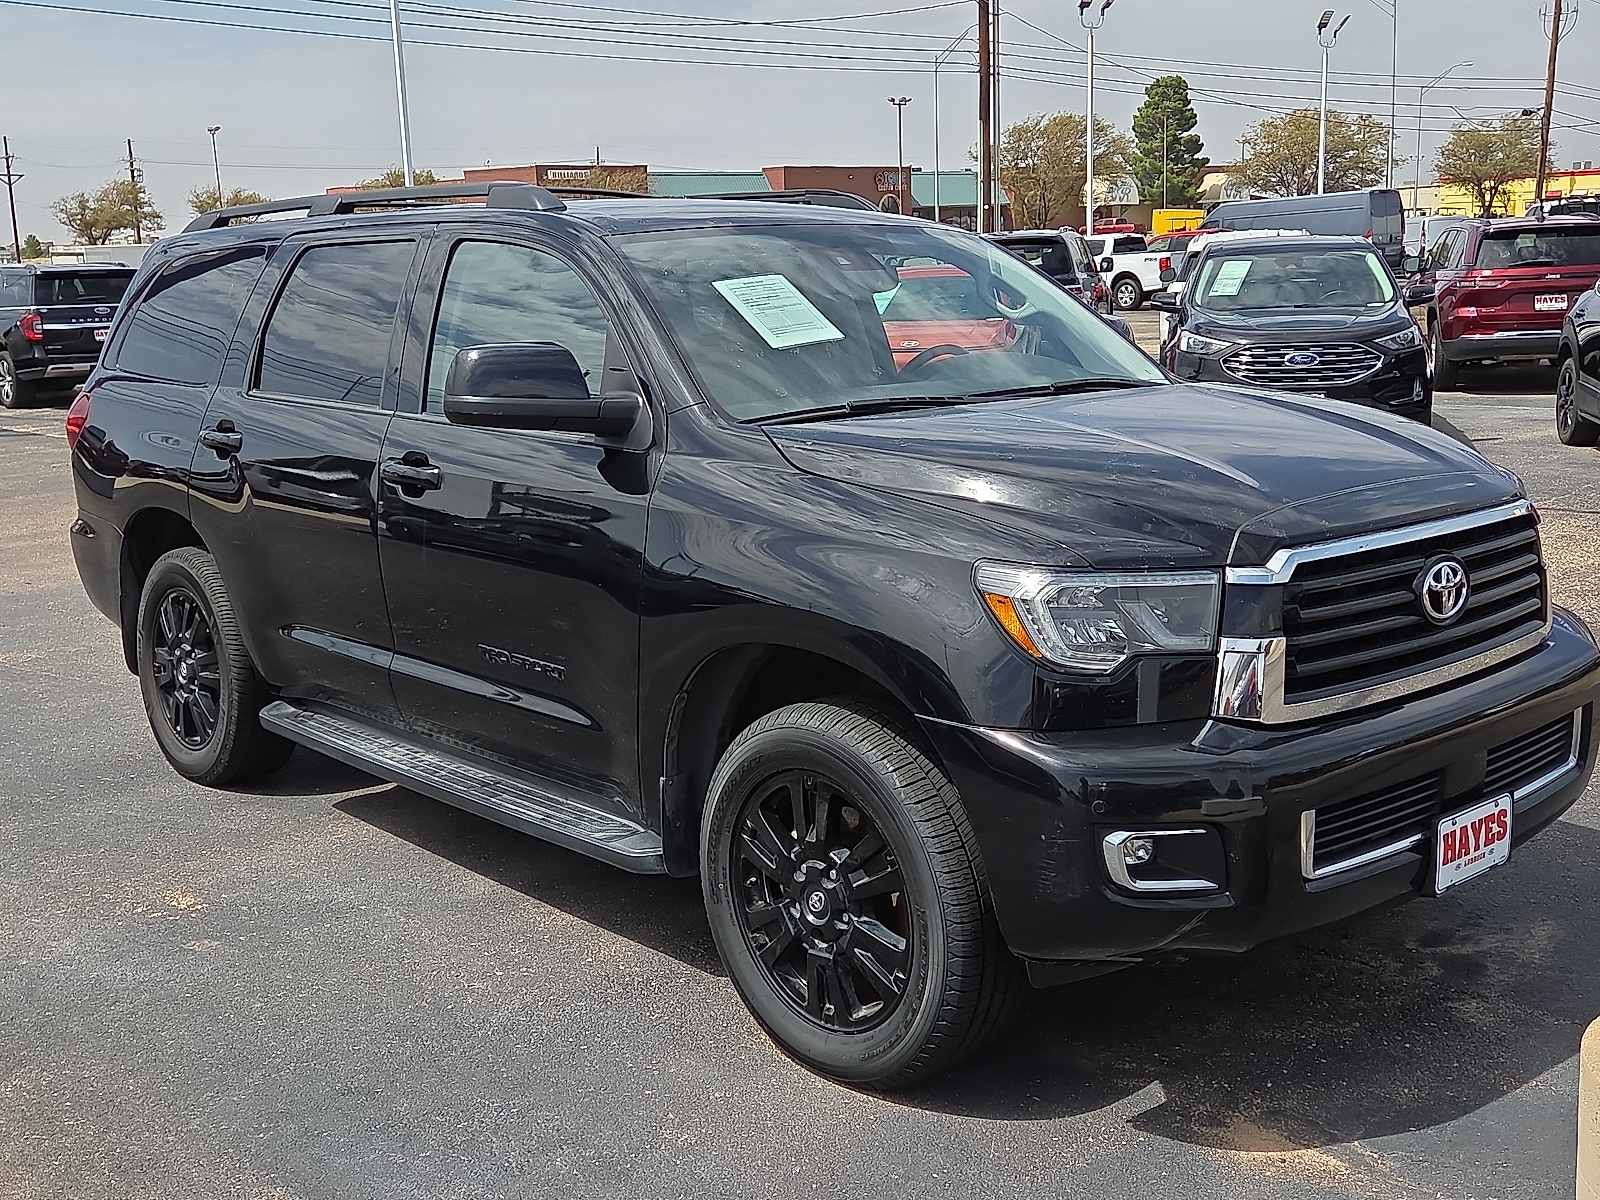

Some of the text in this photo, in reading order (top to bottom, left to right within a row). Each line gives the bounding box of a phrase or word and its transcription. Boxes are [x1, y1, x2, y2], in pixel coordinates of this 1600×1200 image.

[1536, 296, 1566, 304] HAYES
[511, 653, 567, 681] SPORT
[1442, 808, 1508, 867] HAYES
